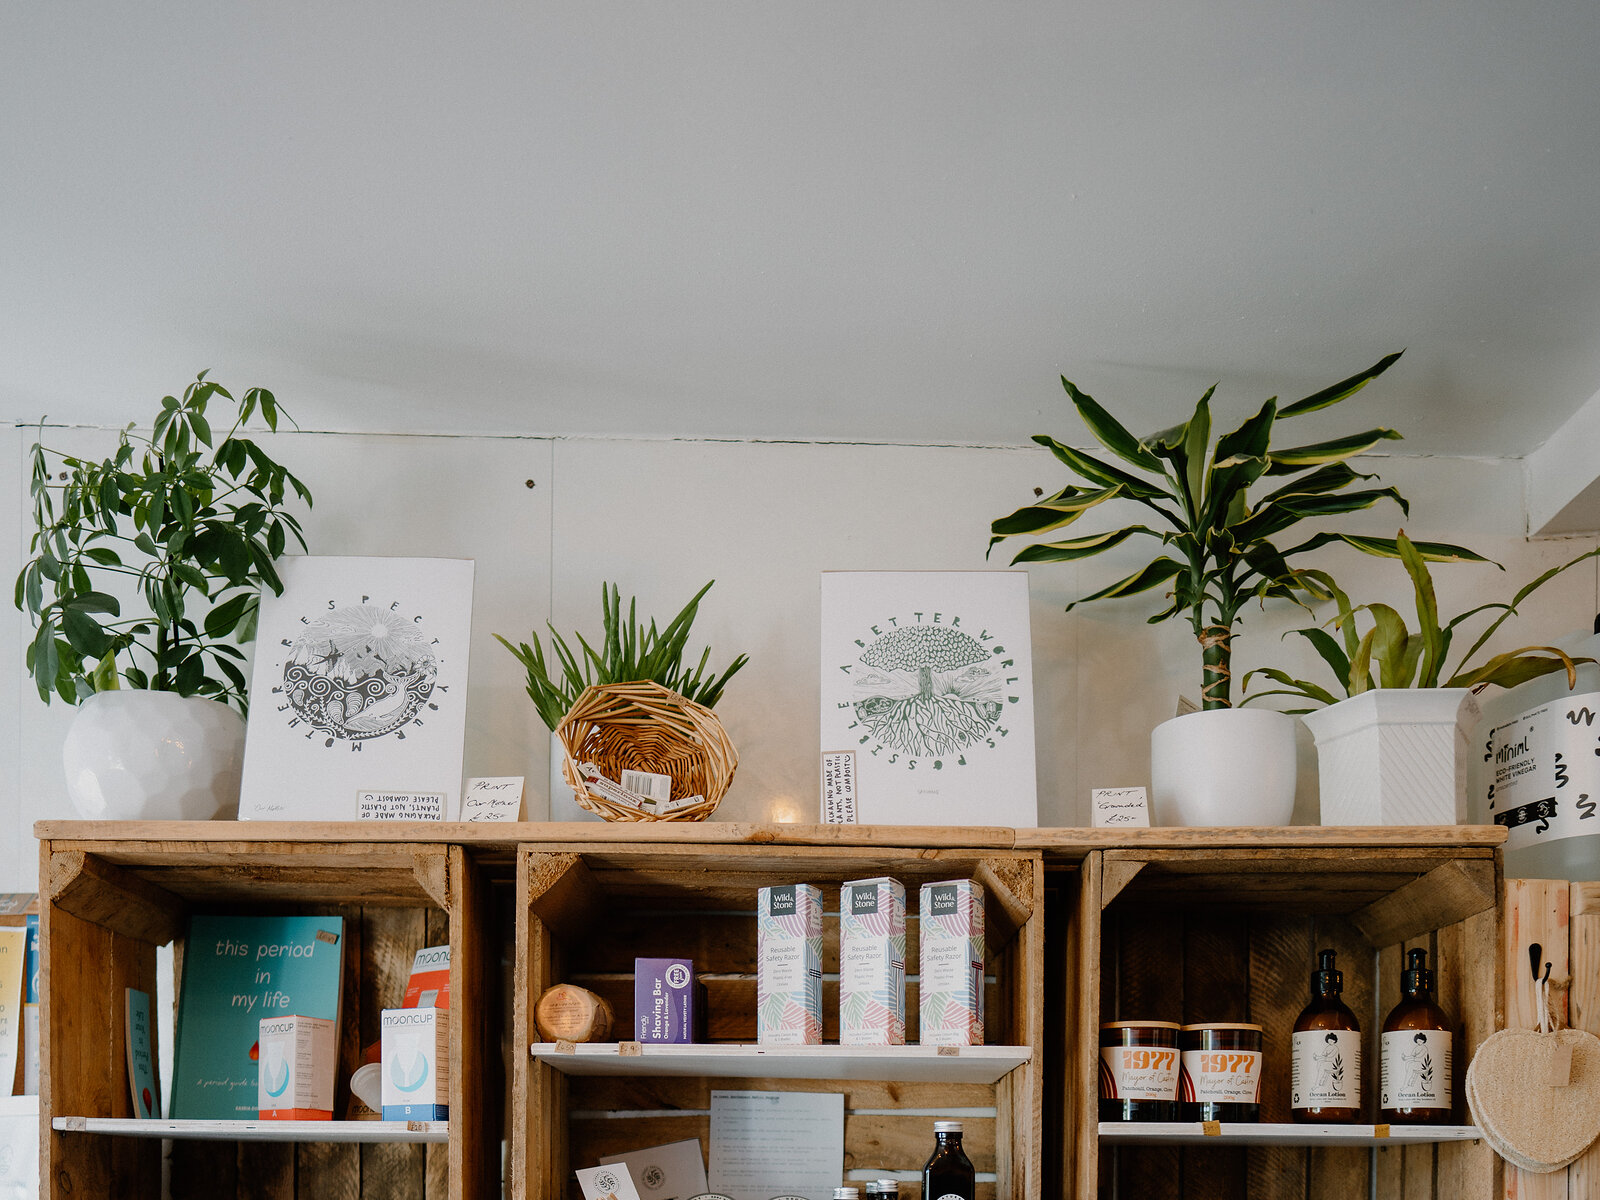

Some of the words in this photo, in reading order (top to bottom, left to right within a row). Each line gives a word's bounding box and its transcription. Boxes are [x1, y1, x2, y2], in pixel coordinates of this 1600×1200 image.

[854, 612, 961, 649] BETTER
[979, 629, 1019, 704] WORLD
[838, 701, 967, 770] POSSIBLE
[1496, 757, 1535, 776] ECO-FRIENDLY
[1496, 773, 1512, 783] WHITE
[1512, 764, 1537, 777] VINEGAR
[473, 781, 515, 791] PRINT
[413, 796, 439, 804] PLEASE
[408, 804, 440, 812] PLANTS,
[845, 797, 854, 822] PLEASE
[398, 813, 441, 821] PACKAGING
[773, 893, 790, 902] Wild
[855, 892, 873, 901] Wild
[934, 893, 952, 901] Wild
[773, 901, 793, 910] Stone
[855, 900, 876, 909] Stone
[934, 900, 955, 909] Stone
[215, 939, 248, 956] this
[256, 941, 315, 962] period
[852, 945, 878, 953] Reusable
[931, 945, 957, 953] Reusable
[766, 954, 783, 962] Safety
[784, 953, 800, 961] Razor
[847, 953, 864, 962] Safety
[865, 952, 882, 960] Razor
[944, 953, 962, 961] Razor
[255, 968, 271, 984] in
[653, 977, 662, 996] Bar
[231, 993, 257, 1013] my
[262, 990, 290, 1009] life
[652, 997, 664, 1040] Shaving
[640, 1014, 648, 1040] Friendly
[1122, 1051, 1175, 1070] 1977
[1200, 1054, 1255, 1073] 1977
[1122, 1073, 1147, 1087] Mayor
[1200, 1076, 1225, 1089] Mayor
[405, 1106, 411, 1115] B
